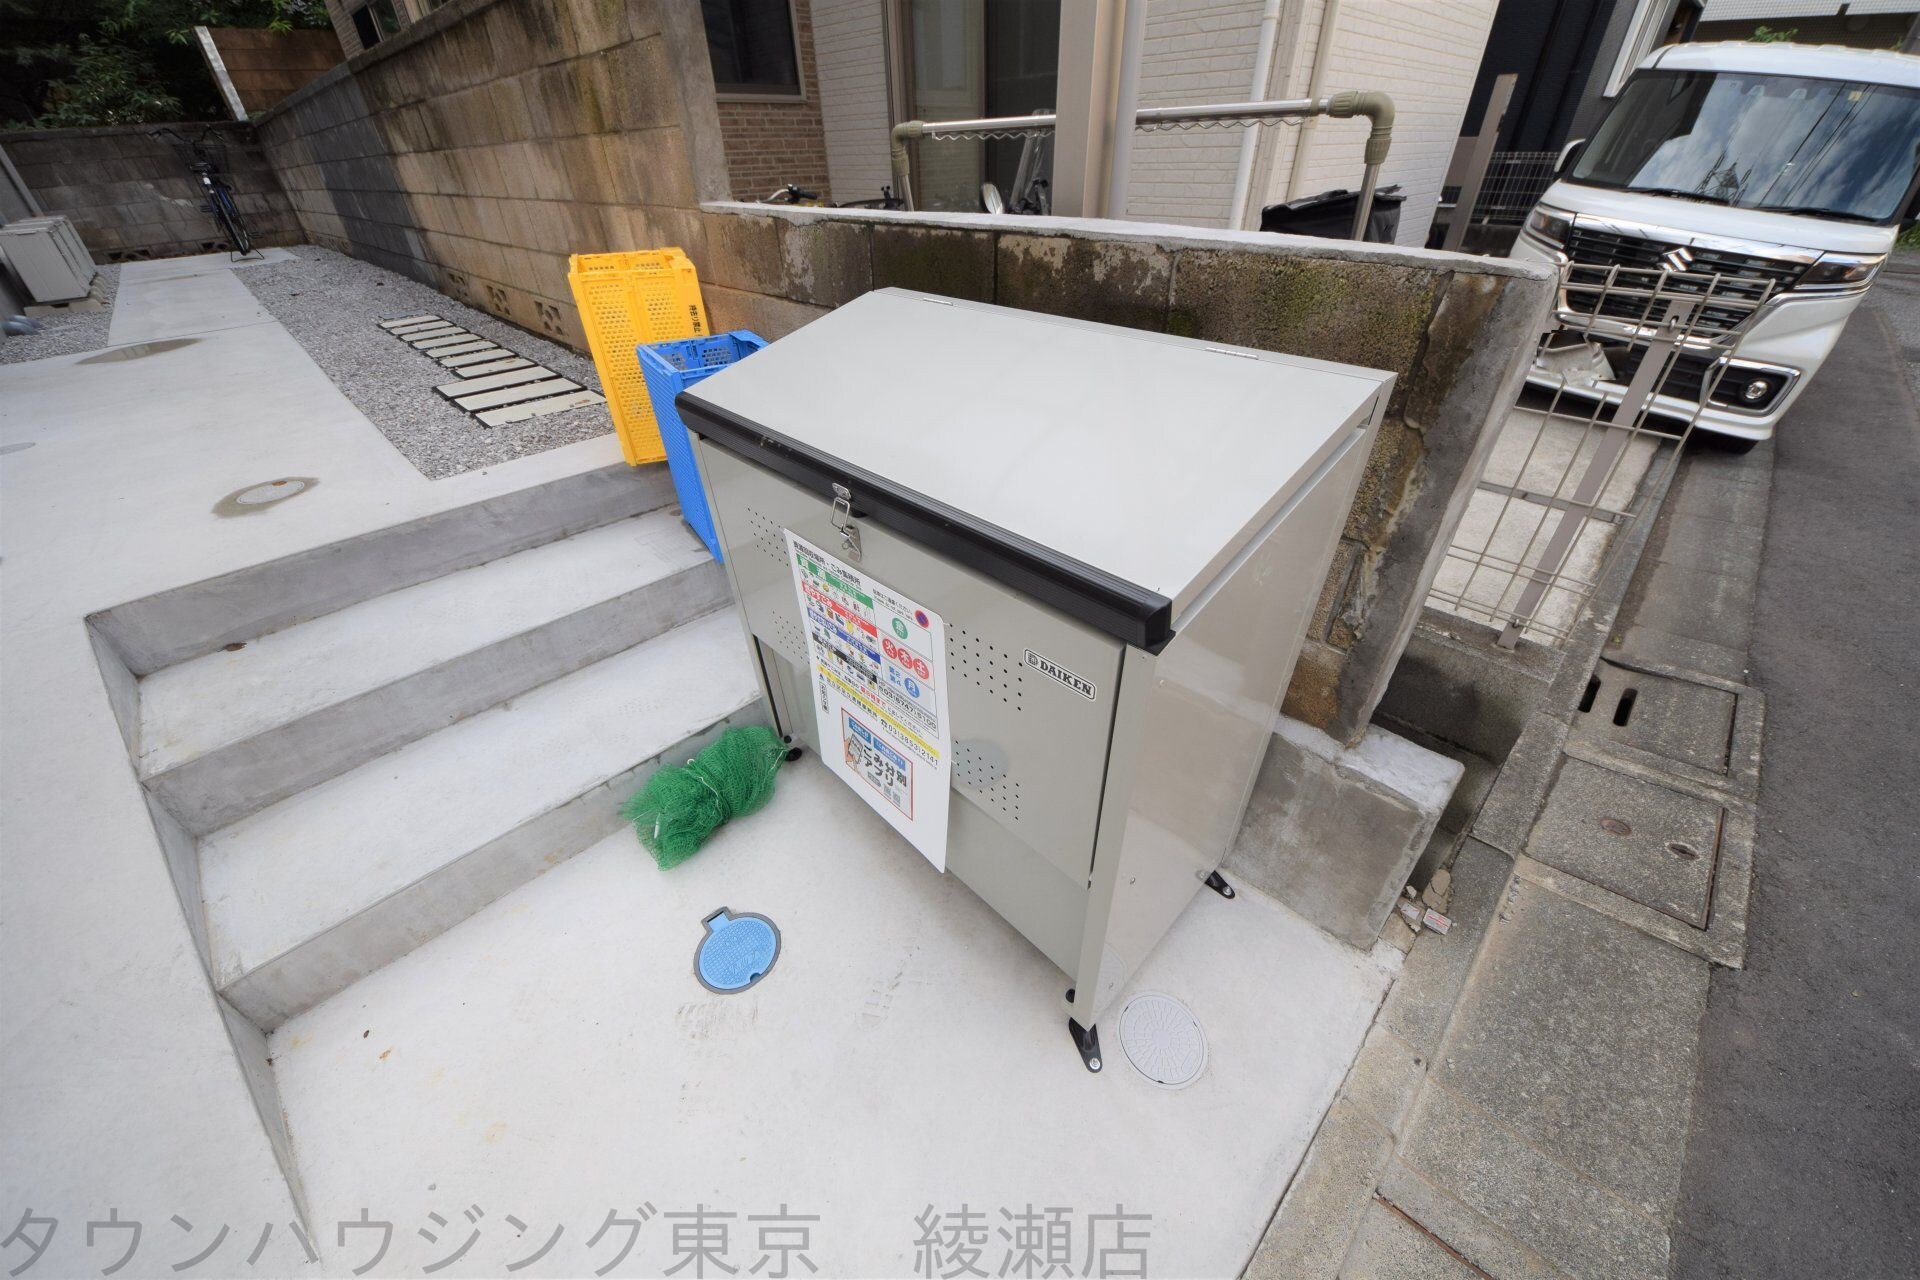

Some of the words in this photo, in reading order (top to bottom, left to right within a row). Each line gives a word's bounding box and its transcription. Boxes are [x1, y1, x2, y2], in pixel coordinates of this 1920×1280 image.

[1040, 660, 1092, 695] DAIKEN
[863, 744, 907, 787] ごみ分別
[864, 755, 894, 786] アプリ
